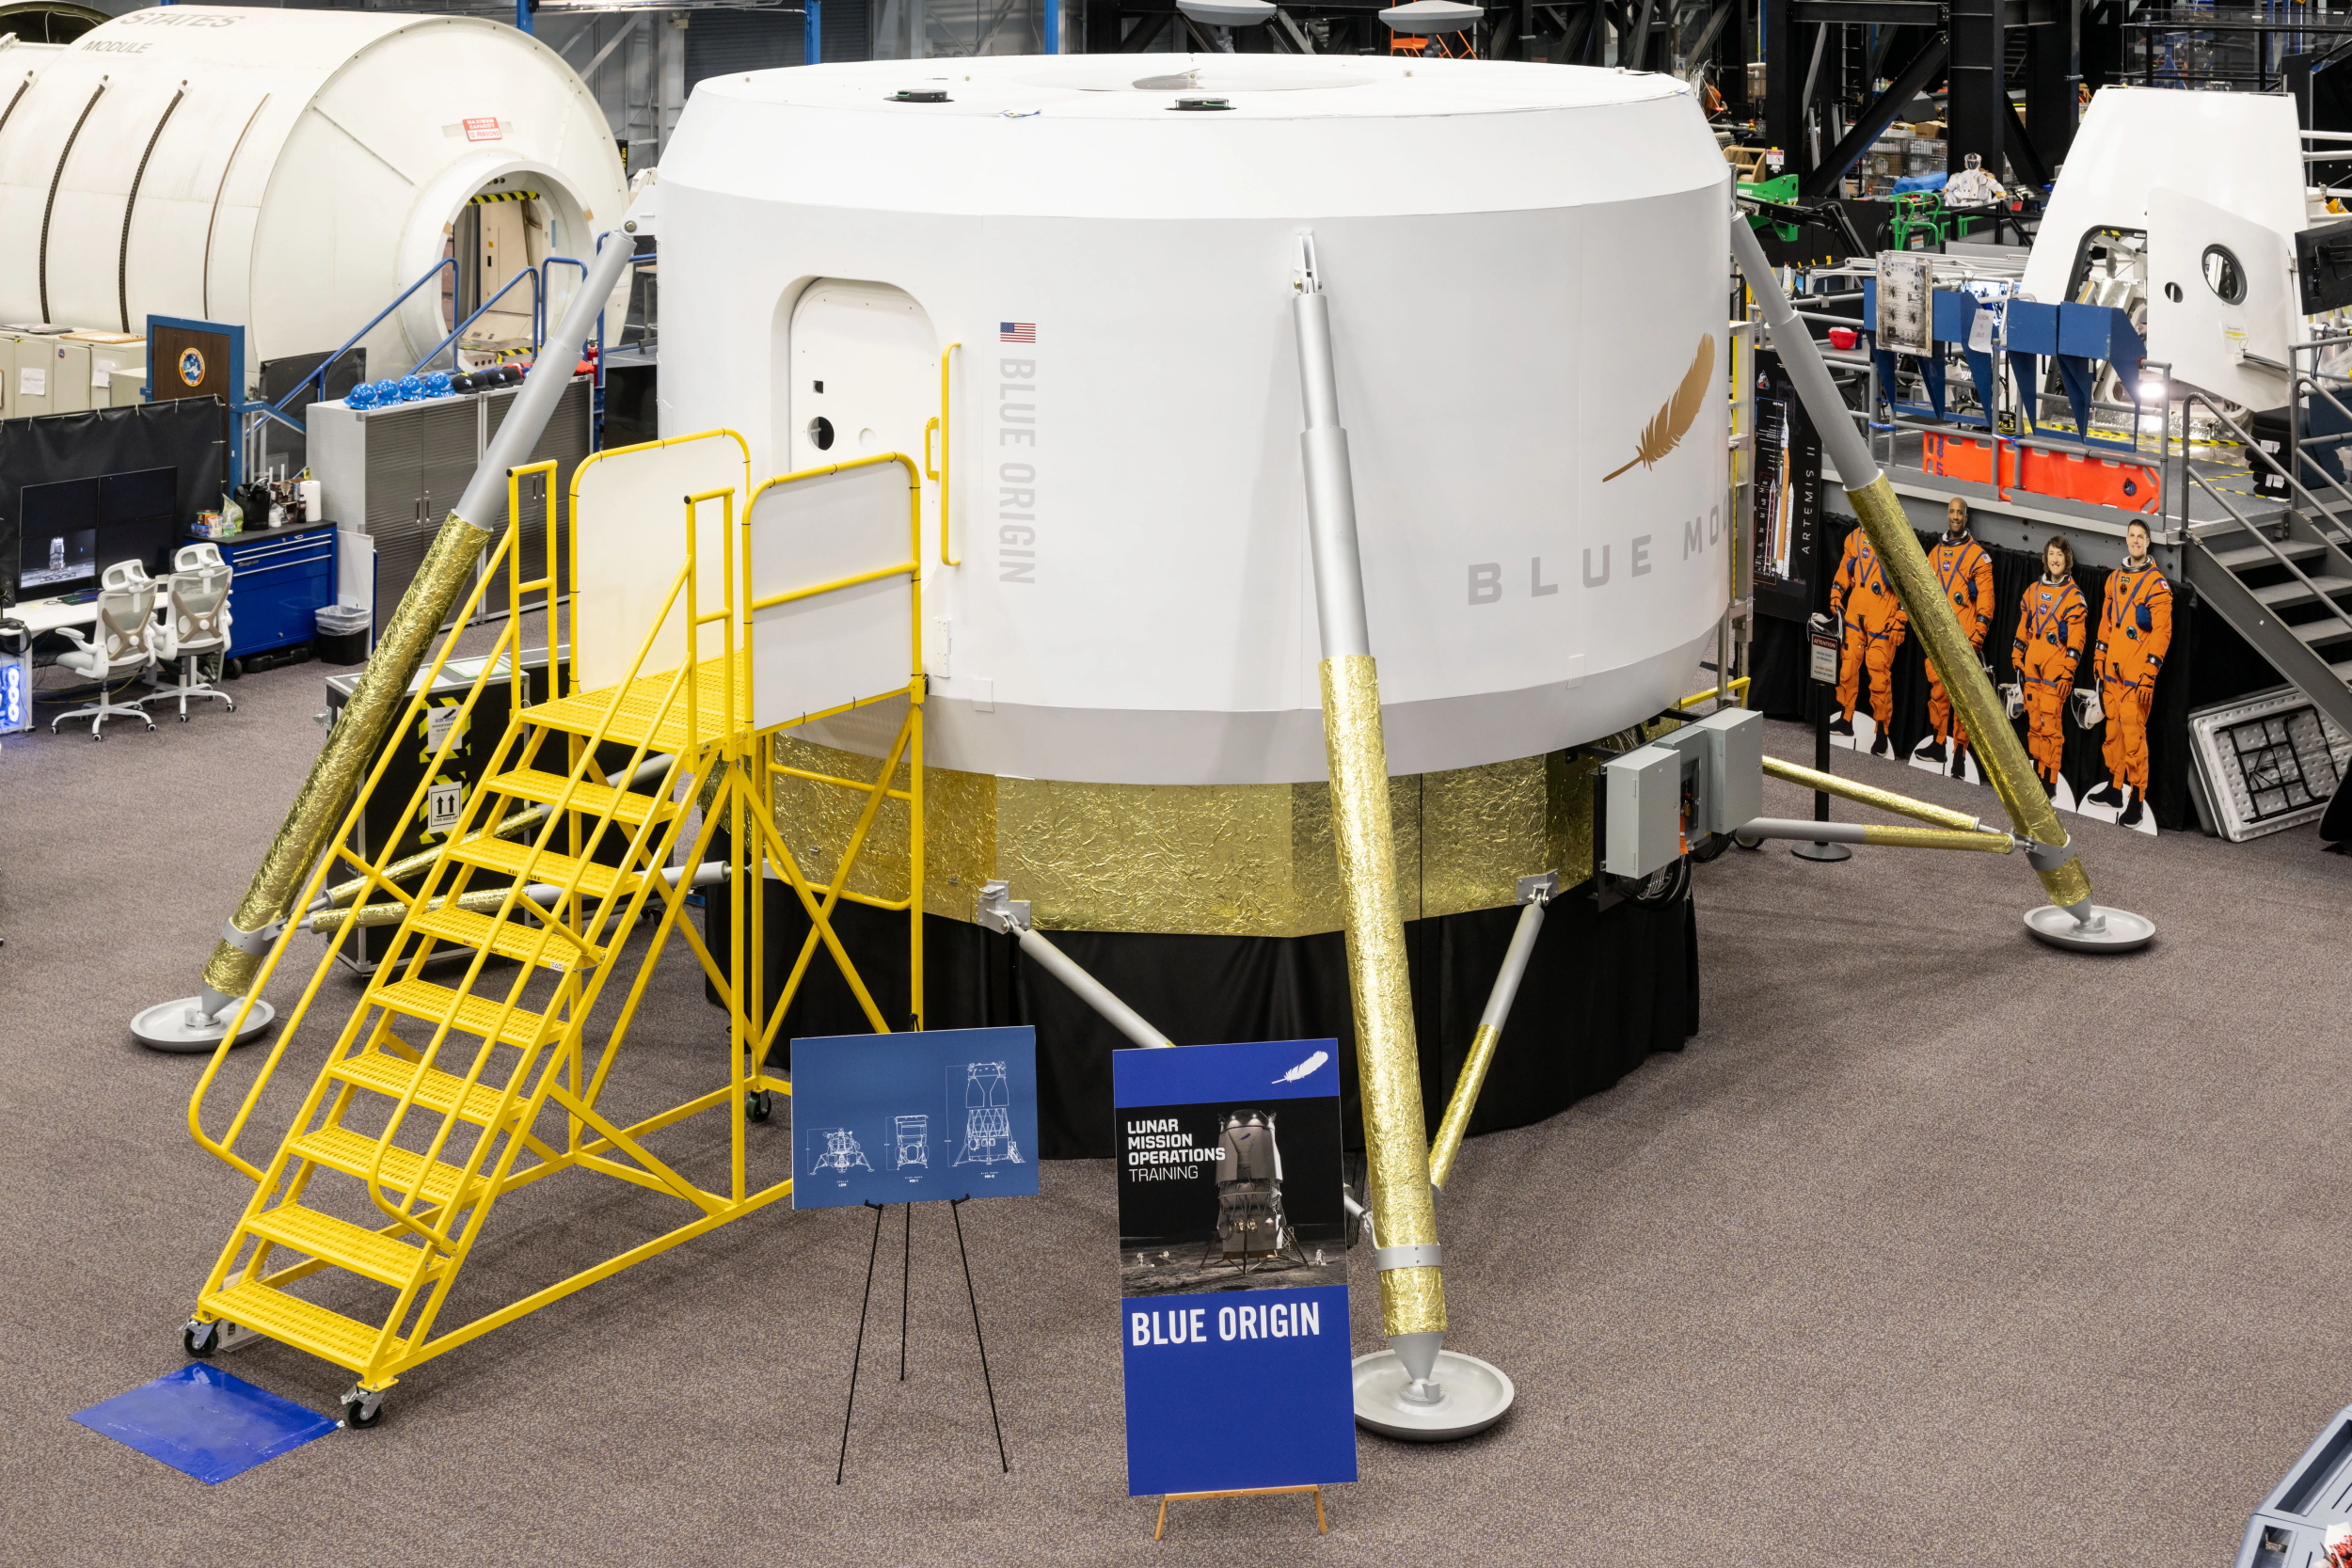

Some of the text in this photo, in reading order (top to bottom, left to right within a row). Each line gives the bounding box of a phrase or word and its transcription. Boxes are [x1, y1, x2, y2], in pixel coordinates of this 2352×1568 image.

[119, 12, 246, 28] STATES
[81, 40, 153, 54] MODULE
[998, 358, 1037, 585] BLUE ORIGIN
[1801, 469, 1815, 555] ARTEMIS
[1468, 534, 1652, 606] BLUE
[1814, 639, 1836, 648] ATTENTION
[508, 868, 541, 881] BALORE
[1127, 1118, 1179, 1134] LUNAR
[1128, 1133, 1193, 1149] MISSION
[1128, 1147, 1226, 1165] OPERATIONS
[1129, 1164, 1199, 1182] TRAINING
[1132, 1302, 1320, 1346] BLUE ORIGIN
